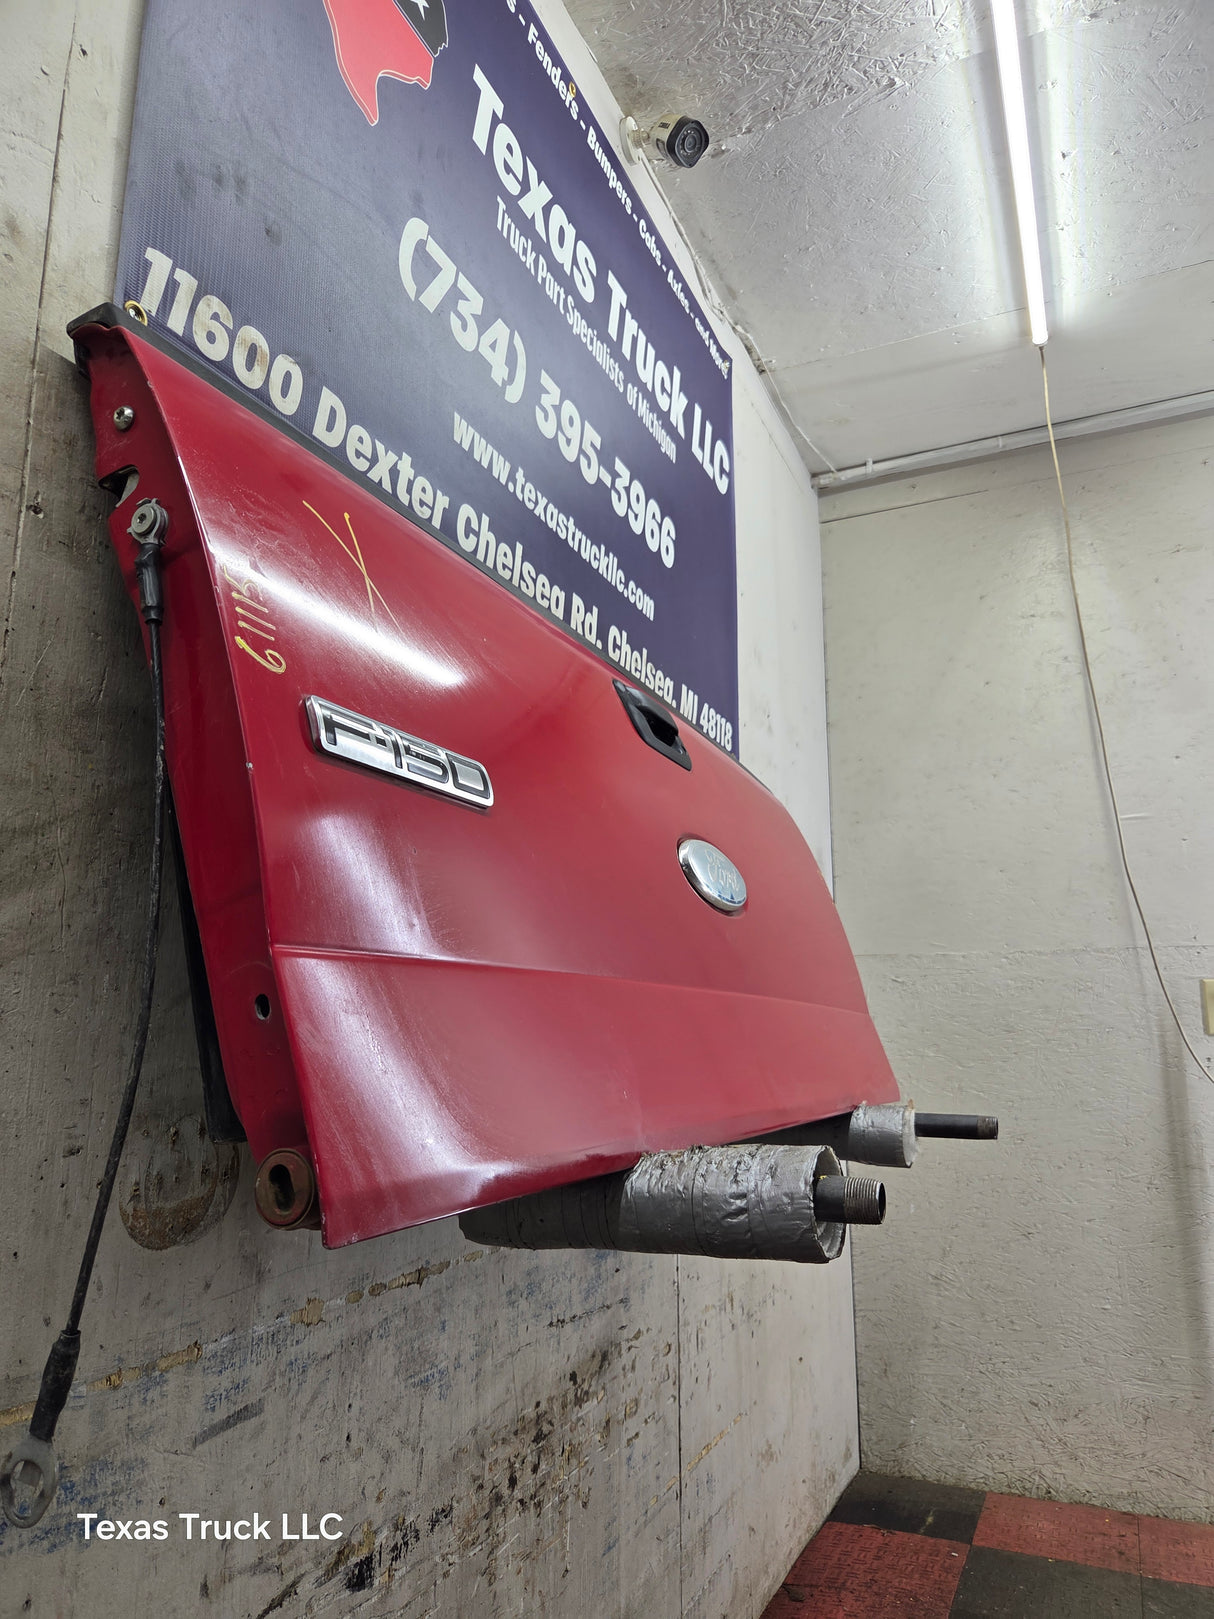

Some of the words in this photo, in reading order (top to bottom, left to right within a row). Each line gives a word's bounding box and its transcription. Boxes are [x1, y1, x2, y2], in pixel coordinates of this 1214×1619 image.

[527, 22, 579, 120] Fenders
[587, 125, 632, 215] Bumpers
[639, 219, 661, 266] Cabs
[398, 217, 527, 404] (734)
[535, 369, 677, 569] 395-3966
[472, 63, 597, 304] Texas
[607, 269, 689, 440] Truck
[691, 402, 730, 495] LLC
[496, 195, 536, 277] Truck
[537, 254, 566, 315] Part
[566, 294, 625, 393] Specialists
[637, 391, 677, 464] Michigan
[139, 247, 304, 416] 11600
[312, 385, 450, 530] Dexter
[456, 503, 566, 621] Chelsea
[570, 592, 603, 650] Rd.
[679, 683, 699, 725] MI
[700, 702, 733, 752] 48118
[453, 411, 655, 622] www.texastruckllc.com
[318, 704, 492, 802] F-150
